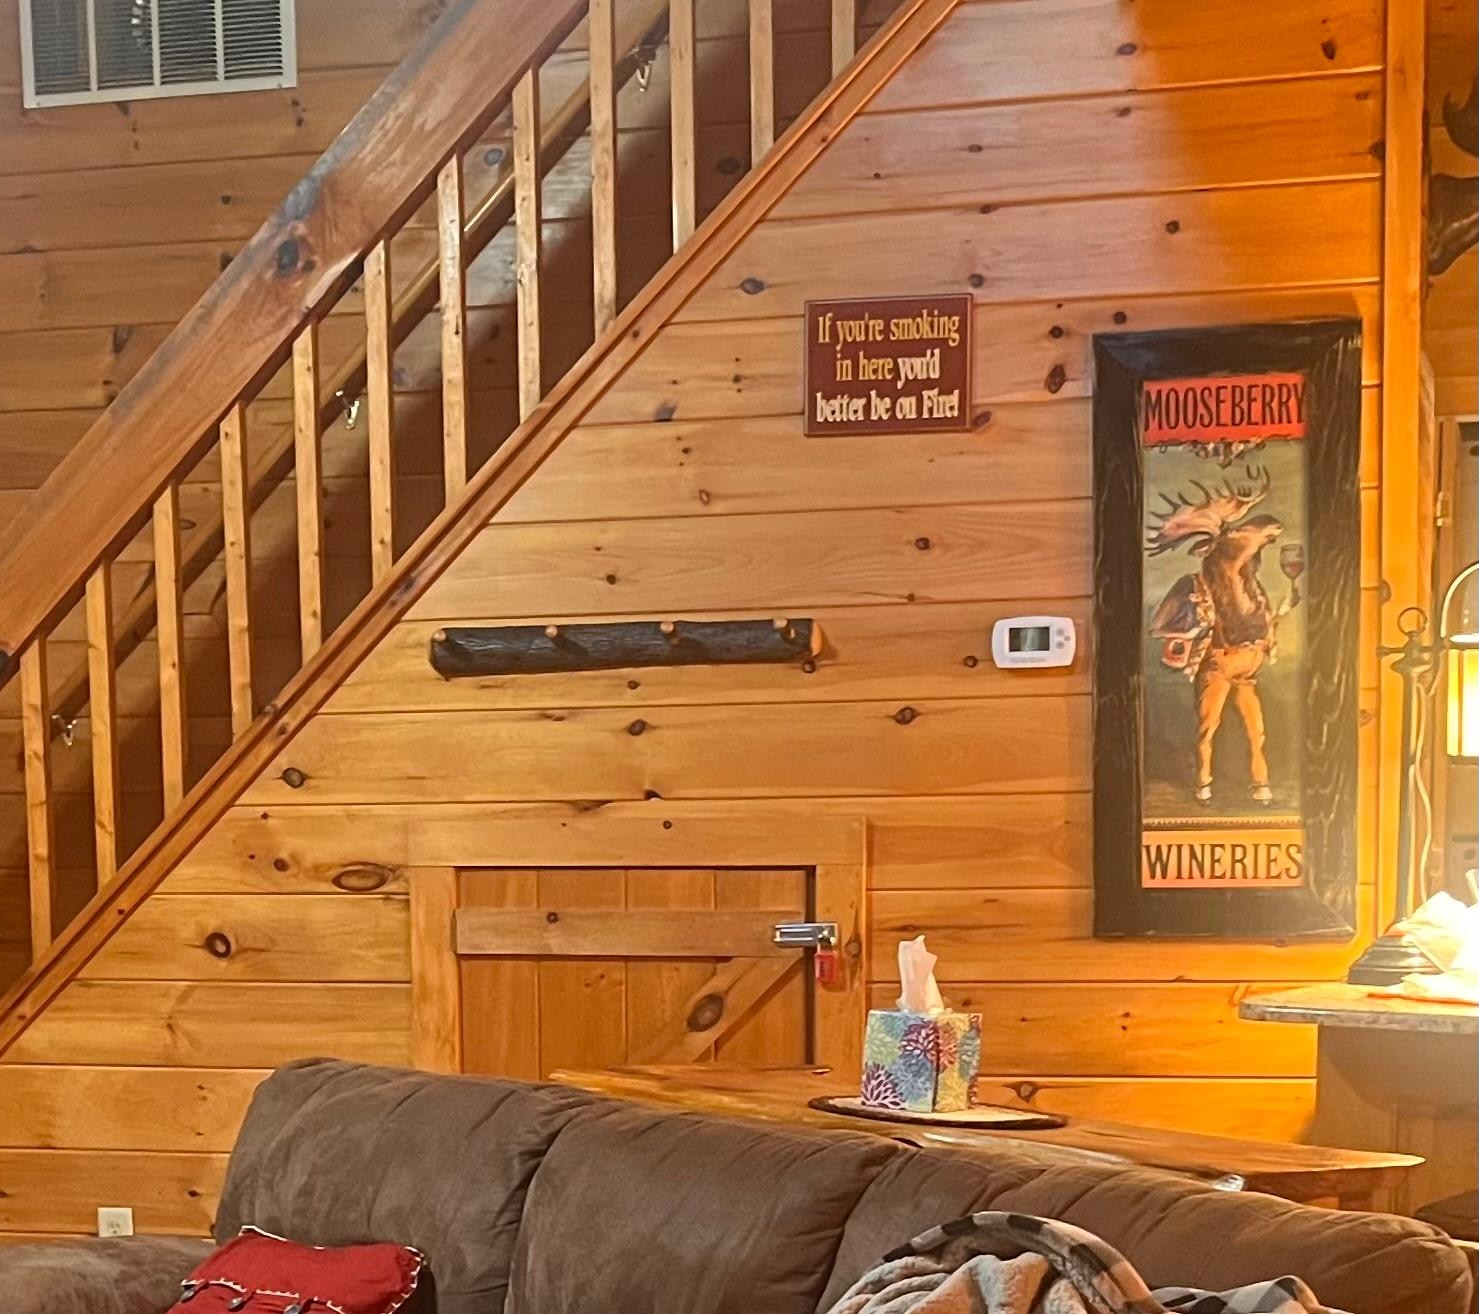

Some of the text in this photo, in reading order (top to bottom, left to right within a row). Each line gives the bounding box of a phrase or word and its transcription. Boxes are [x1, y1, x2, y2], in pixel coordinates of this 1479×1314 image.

[818, 309, 960, 351] If you're smoking
[835, 348, 940, 390] in here you'd
[816, 388, 960, 423] better be on Fire!
[1143, 382, 1306, 432] MOOSEBERRY
[1142, 842, 1303, 881] WINERIES
